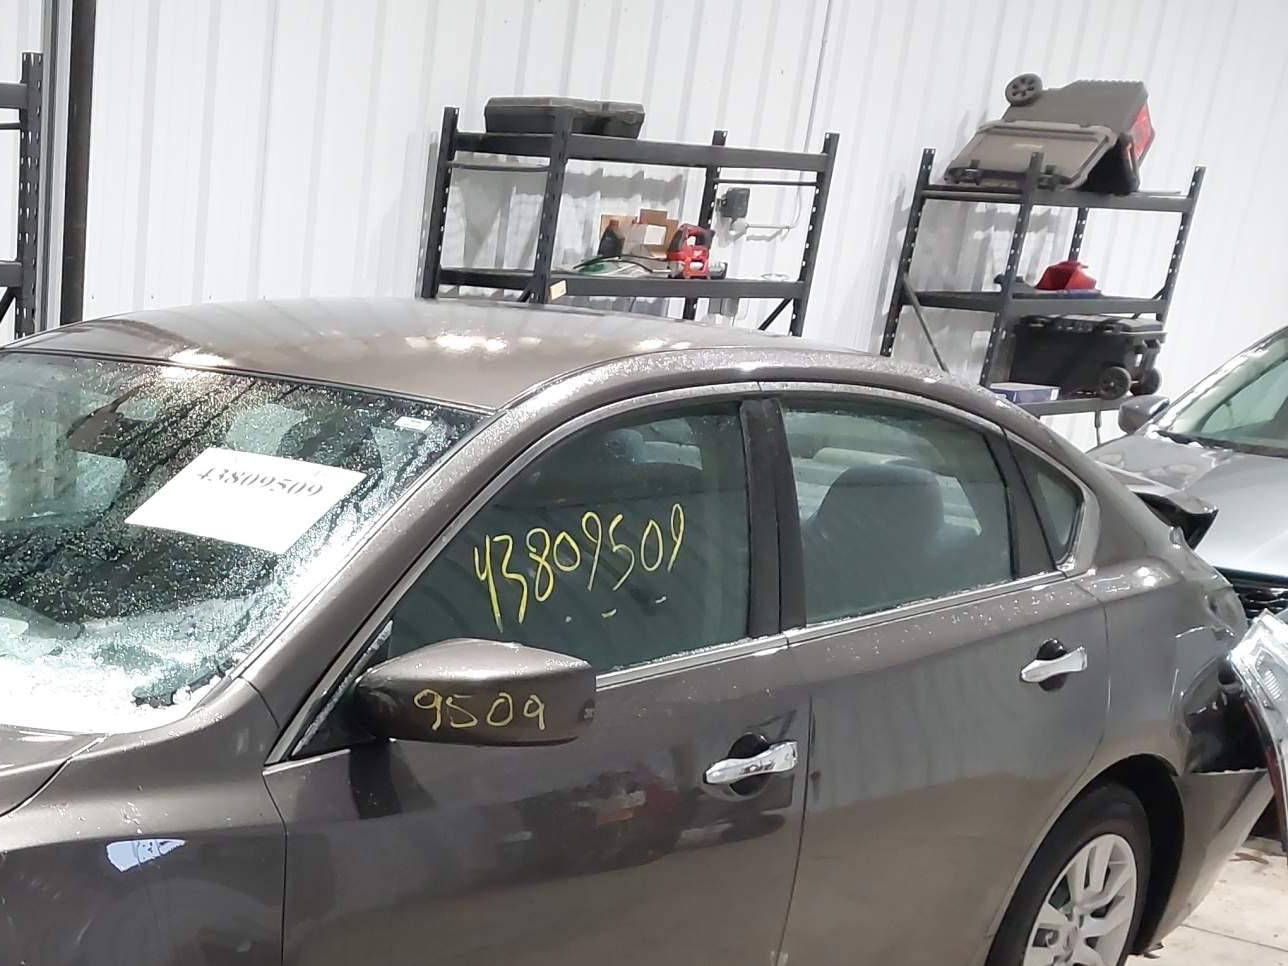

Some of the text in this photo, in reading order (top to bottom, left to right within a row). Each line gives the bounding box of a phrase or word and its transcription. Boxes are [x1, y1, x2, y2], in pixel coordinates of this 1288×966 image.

[198, 466, 325, 496] 43809509
[473, 503, 685, 633] 43809509
[413, 688, 546, 731] 9509
